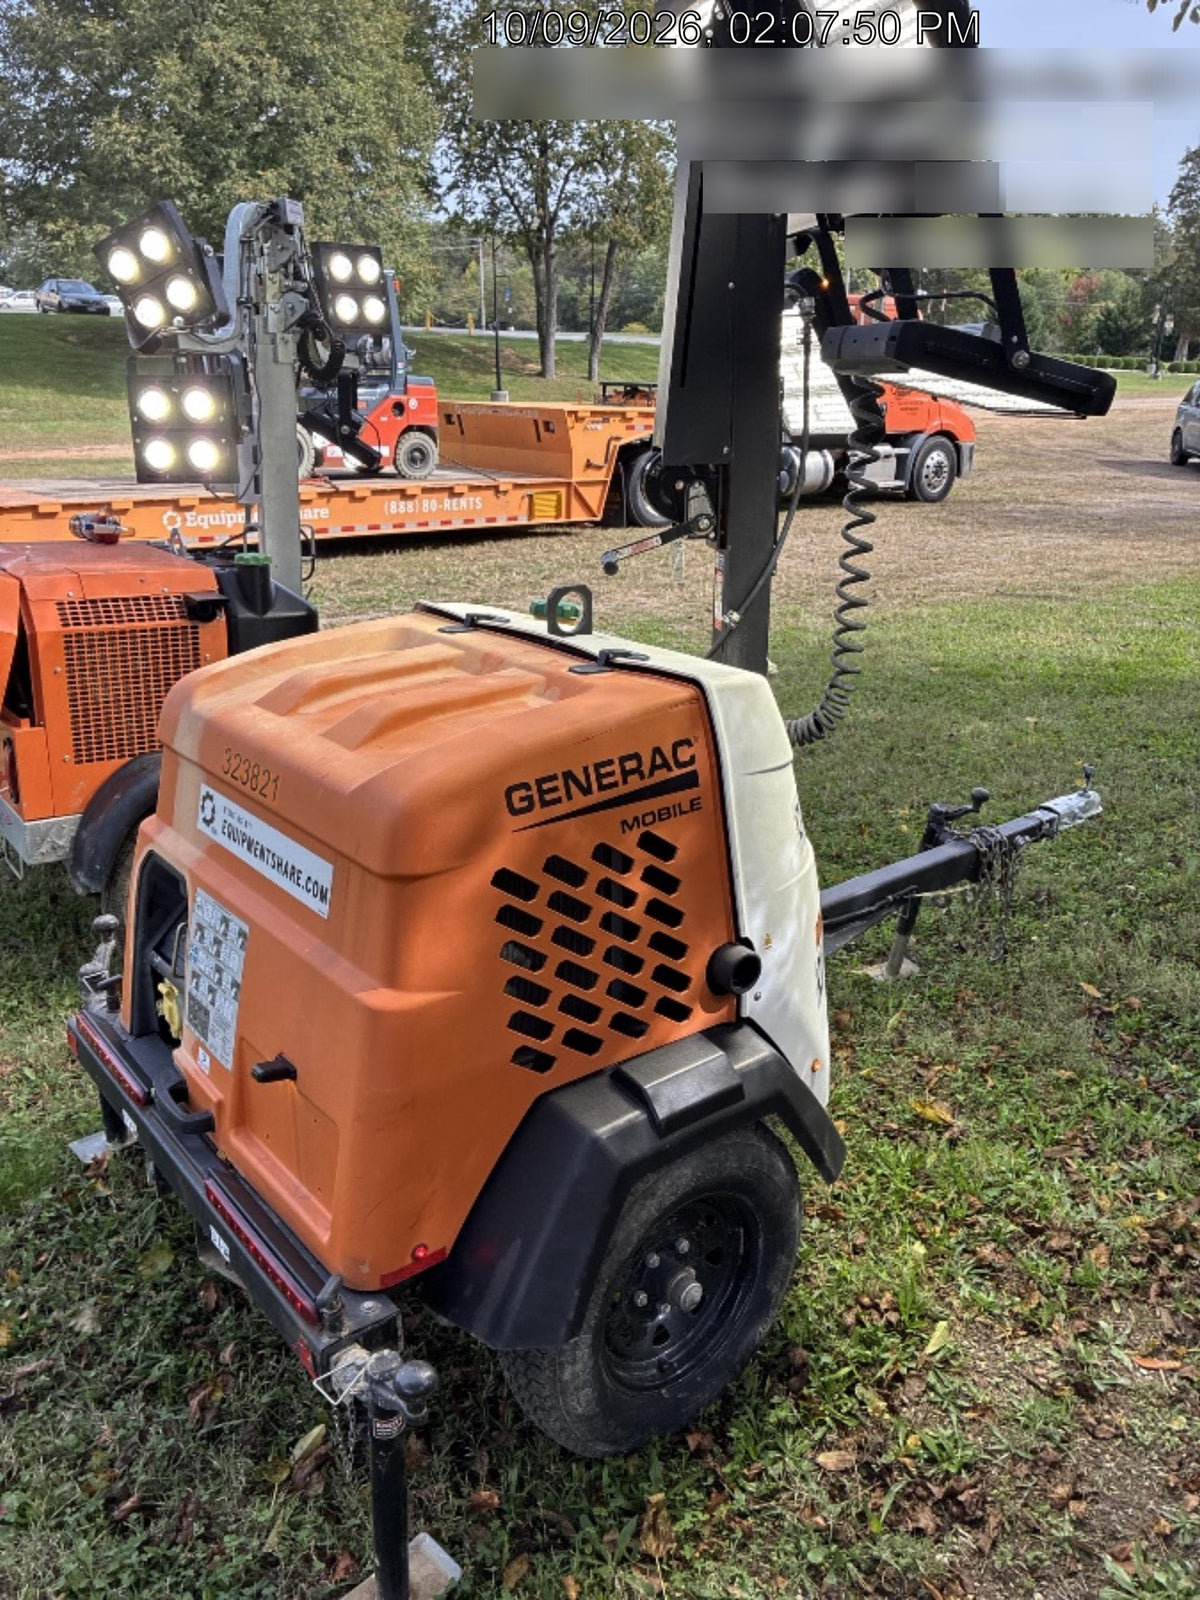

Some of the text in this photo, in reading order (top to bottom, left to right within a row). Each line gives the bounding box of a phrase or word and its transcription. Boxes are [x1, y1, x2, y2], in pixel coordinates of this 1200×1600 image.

[221, 748, 280, 801] 323821
[504, 737, 696, 816] GENERAC
[620, 796, 703, 834] MOBILE
[221, 819, 328, 906] EQUIPMENTSHARE.COM
